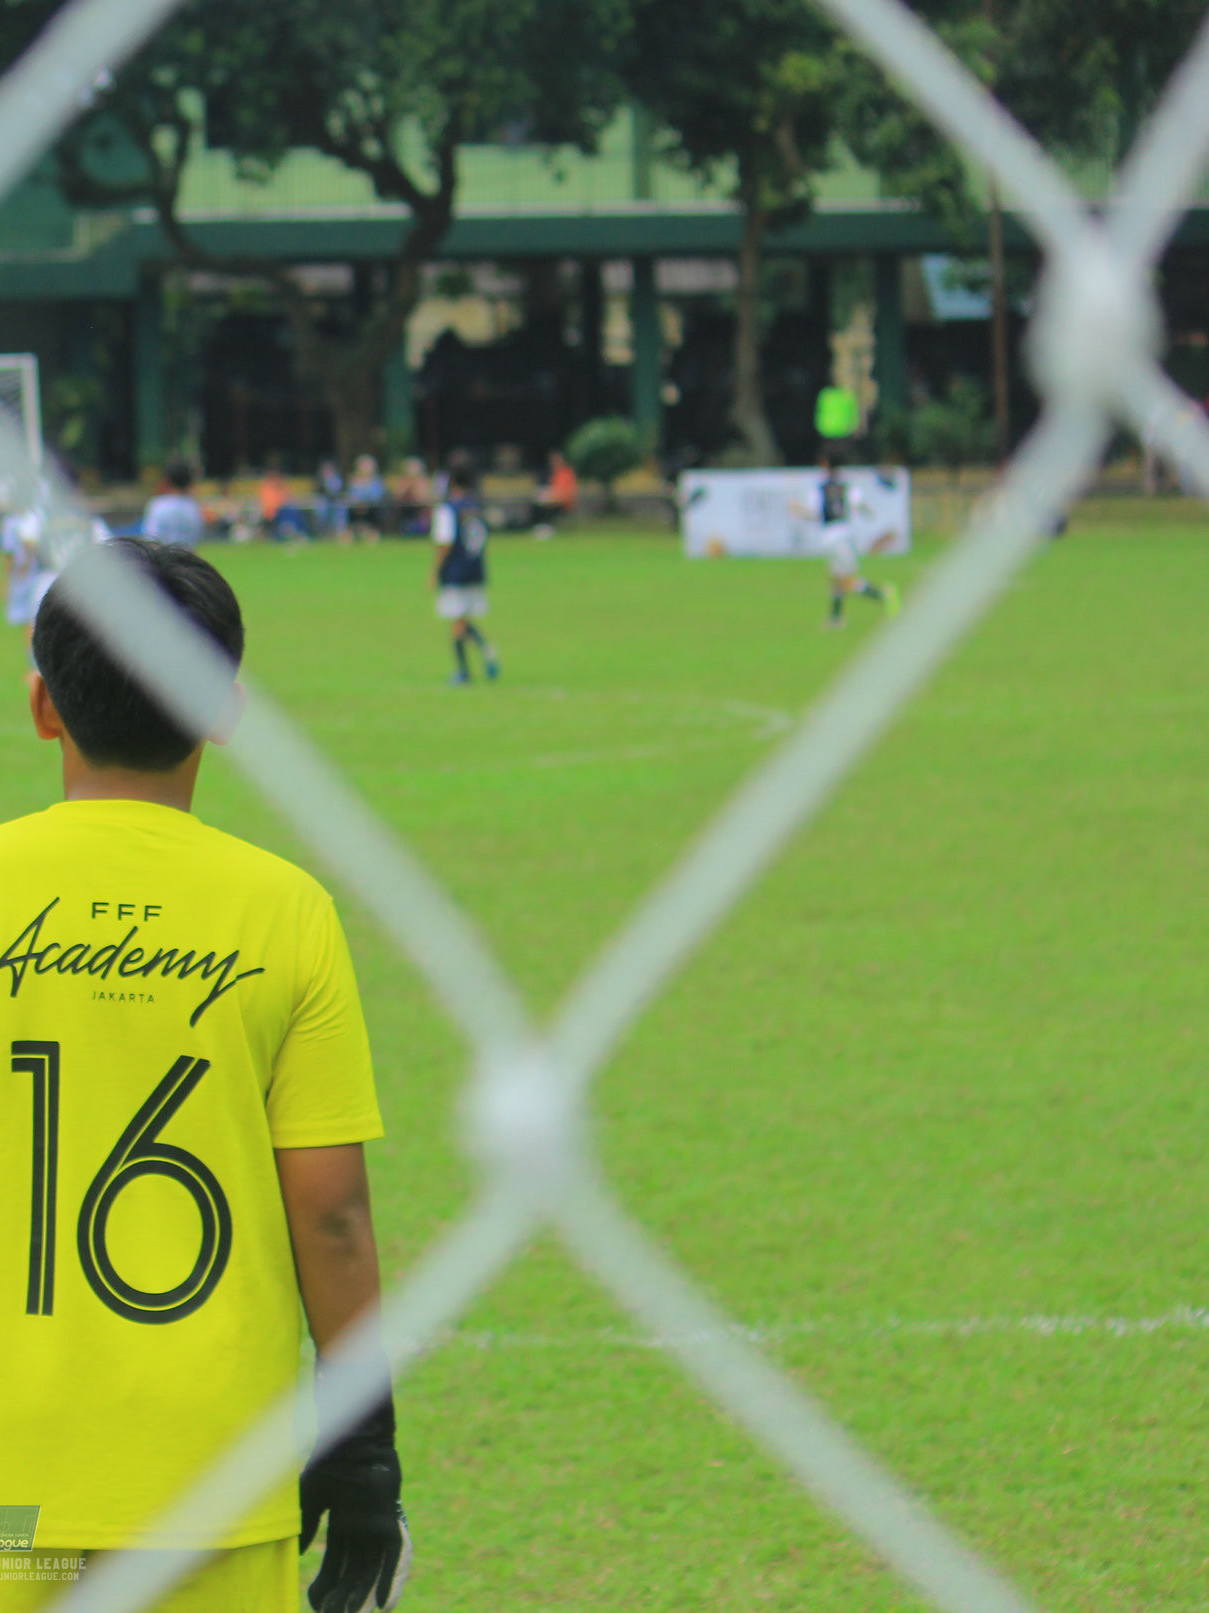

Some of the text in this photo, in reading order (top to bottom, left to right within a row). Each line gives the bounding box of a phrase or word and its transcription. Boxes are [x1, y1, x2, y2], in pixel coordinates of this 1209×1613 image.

[91, 902, 162, 922] FFF
[92, 991, 155, 1004] JAKARTA
[11, 1040, 233, 1325] 16
